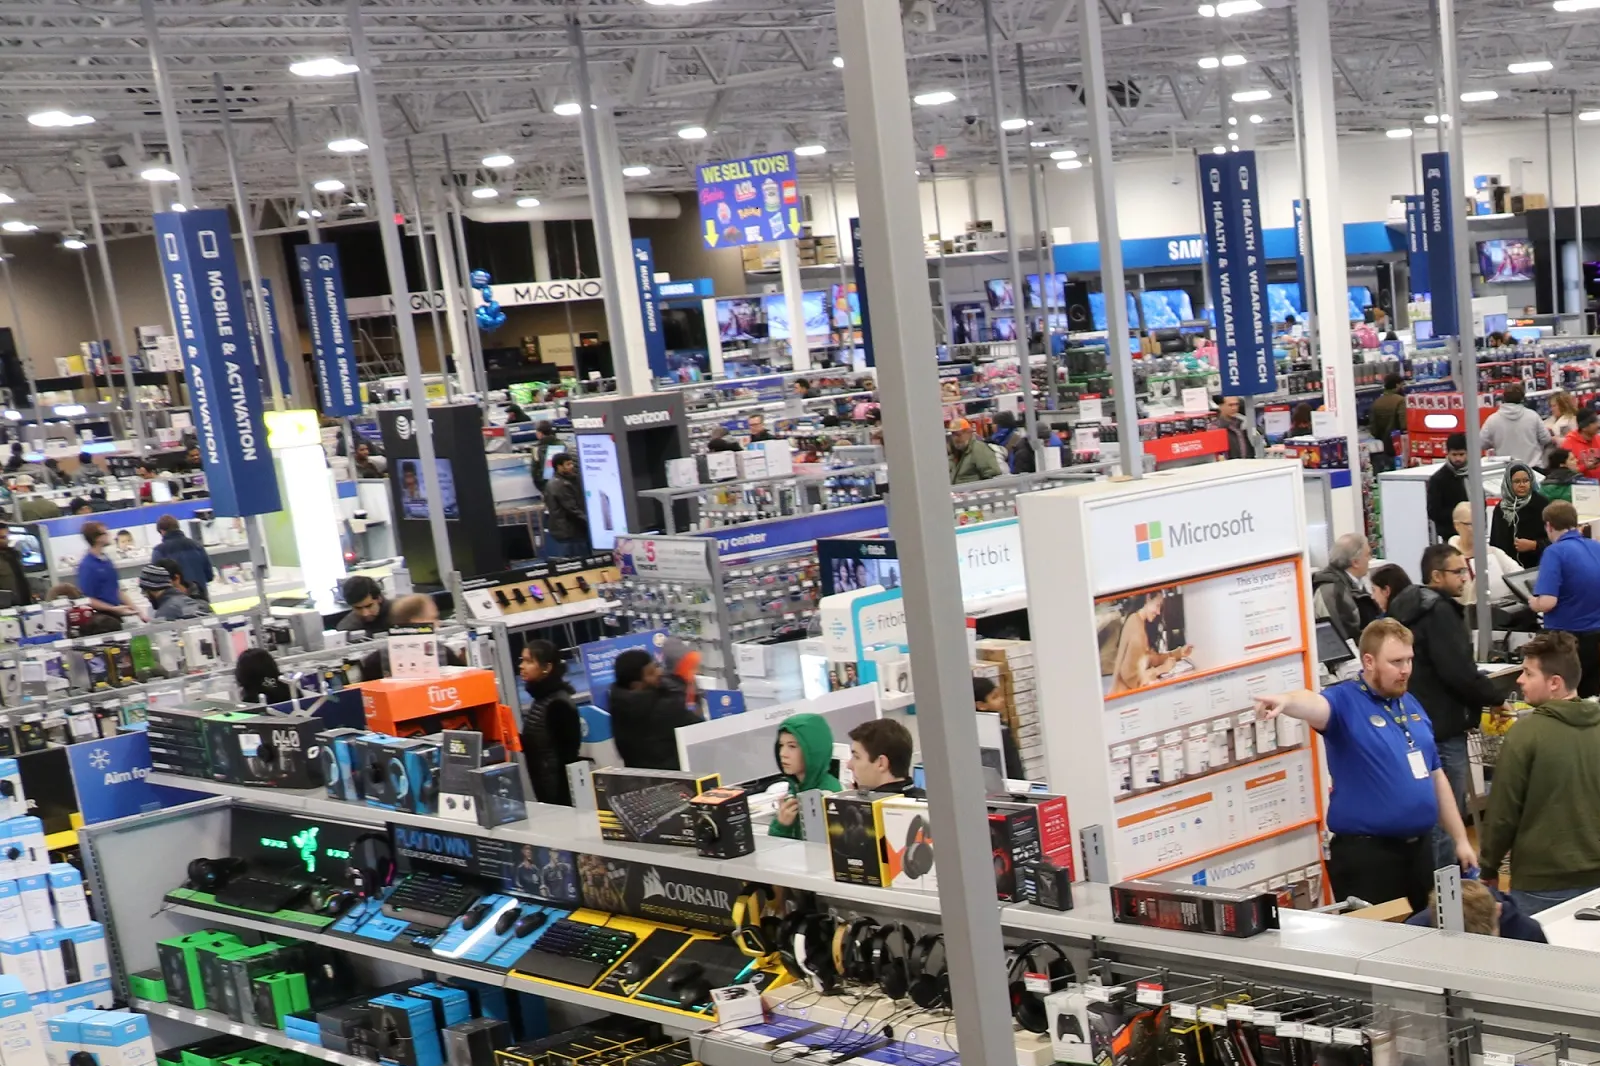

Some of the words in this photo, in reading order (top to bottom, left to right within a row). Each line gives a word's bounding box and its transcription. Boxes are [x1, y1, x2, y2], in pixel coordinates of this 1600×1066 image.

[701, 165, 722, 184] WE
[721, 161, 752, 180] SELL
[750, 154, 790, 176] TOYS!
[1242, 198, 1255, 251] HEALTH
[1431, 188, 1441, 232] GAMING
[1212, 200, 1227, 253] HEALTH
[1218, 257, 1229, 268] &
[1247, 255, 1257, 266] &
[207, 270, 233, 336] MOBILE
[514, 280, 601, 303] MAGNO
[639, 264, 650, 288] MUSIC
[645, 302, 656, 333] MOVIES
[660, 283, 695, 296] SAMSUNG
[172, 273, 195, 340] MOBILE
[323, 277, 344, 343] HEADPHONES
[1219, 272, 1236, 347] WEARABLE
[1248, 270, 1264, 345] WEARABLE
[188, 346, 198, 359] &
[221, 342, 230, 356] &
[336, 346, 343, 355] &
[1227, 351, 1240, 386] TECH
[1256, 348, 1268, 384] TECH
[337, 358, 354, 406] SPEAKERS
[191, 364, 220, 464] ACTIVATION
[225, 360, 257, 461] ACTIVATION
[623, 410, 670, 426] verizon
[730, 533, 767, 547] center
[1168, 509, 1255, 548] Microsoft
[967, 543, 1011, 569] fitbit
[1236, 575, 1252, 588] This
[1251, 574, 1259, 584] is
[1258, 571, 1277, 585] your
[427, 684, 458, 702] fire
[104, 771, 132, 786] Aim
[132, 767, 152, 779] for
[395, 827, 424, 849] PLAY
[424, 832, 443, 852] TO
[1209, 857, 1256, 882] Windows
[664, 881, 732, 911] CORSAIR
